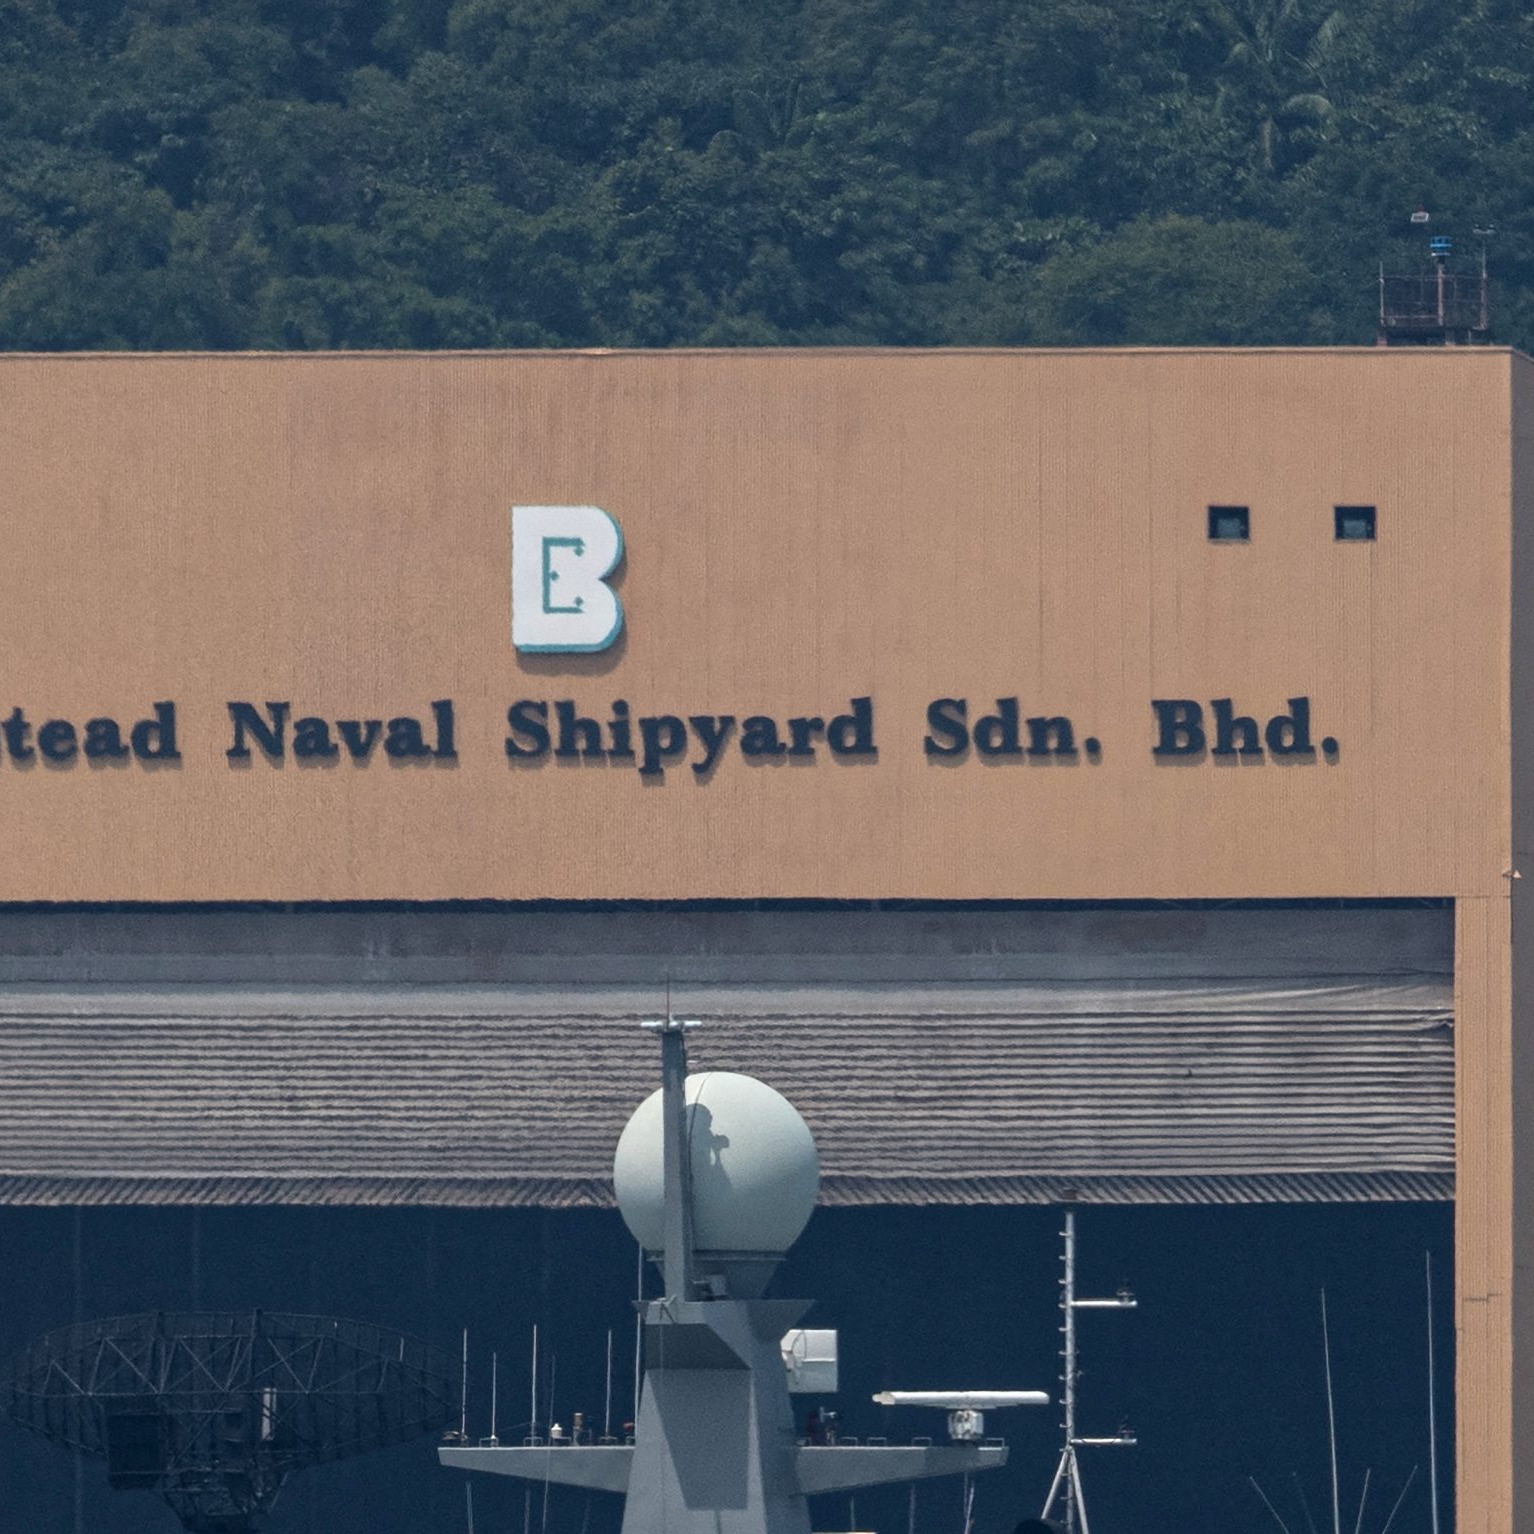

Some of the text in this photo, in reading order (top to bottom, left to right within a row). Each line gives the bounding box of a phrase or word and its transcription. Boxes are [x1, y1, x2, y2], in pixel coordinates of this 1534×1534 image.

[226, 700, 457, 761] Naval
[506, 697, 877, 778] Shipyard
[925, 697, 1100, 758] Sdn.
[1152, 697, 1338, 759] Bhd.
